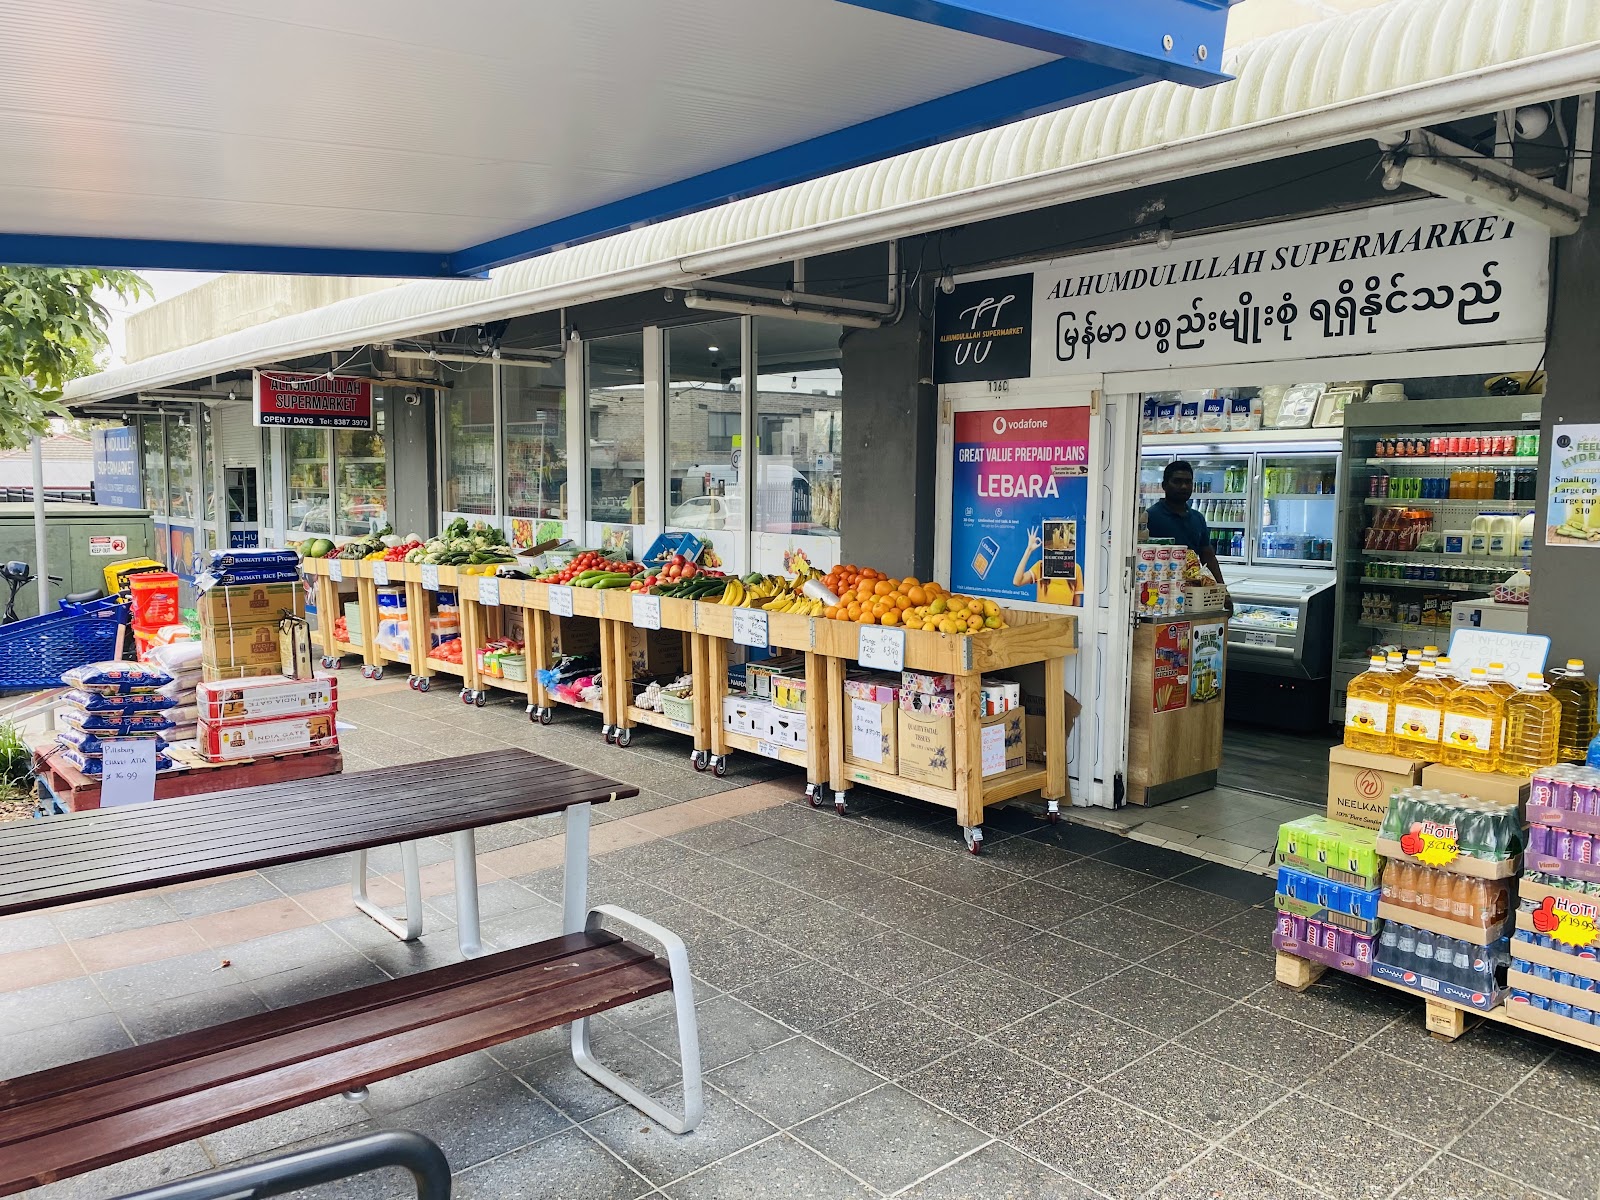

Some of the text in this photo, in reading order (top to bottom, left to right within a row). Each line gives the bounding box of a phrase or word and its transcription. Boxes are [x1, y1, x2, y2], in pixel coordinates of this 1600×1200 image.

[1046, 249, 1267, 300] ALHUMDULILLAH
[940, 327, 1024, 342] ALHUMDULILLAH SUPERMARKET
[1056, 310, 1126, 361] မြန်မာ
[276, 394, 357, 412] SUPERMARKET
[1008, 418, 1048, 429] vodafone
[959, 446, 1085, 462] GREAT VALUE PREPAID PLANS
[978, 474, 1059, 498] LEBARA
[1582, 477, 1597, 485] cup
[1555, 486, 1597, 496] Large cup
[1554, 497, 1579, 505] Large
[908, 723, 938, 735] QUALITY FACIAL
[915, 734, 930, 742] TISSUES
[1424, 823, 1457, 839] HOT!
[1557, 898, 1597, 918] HOT!
